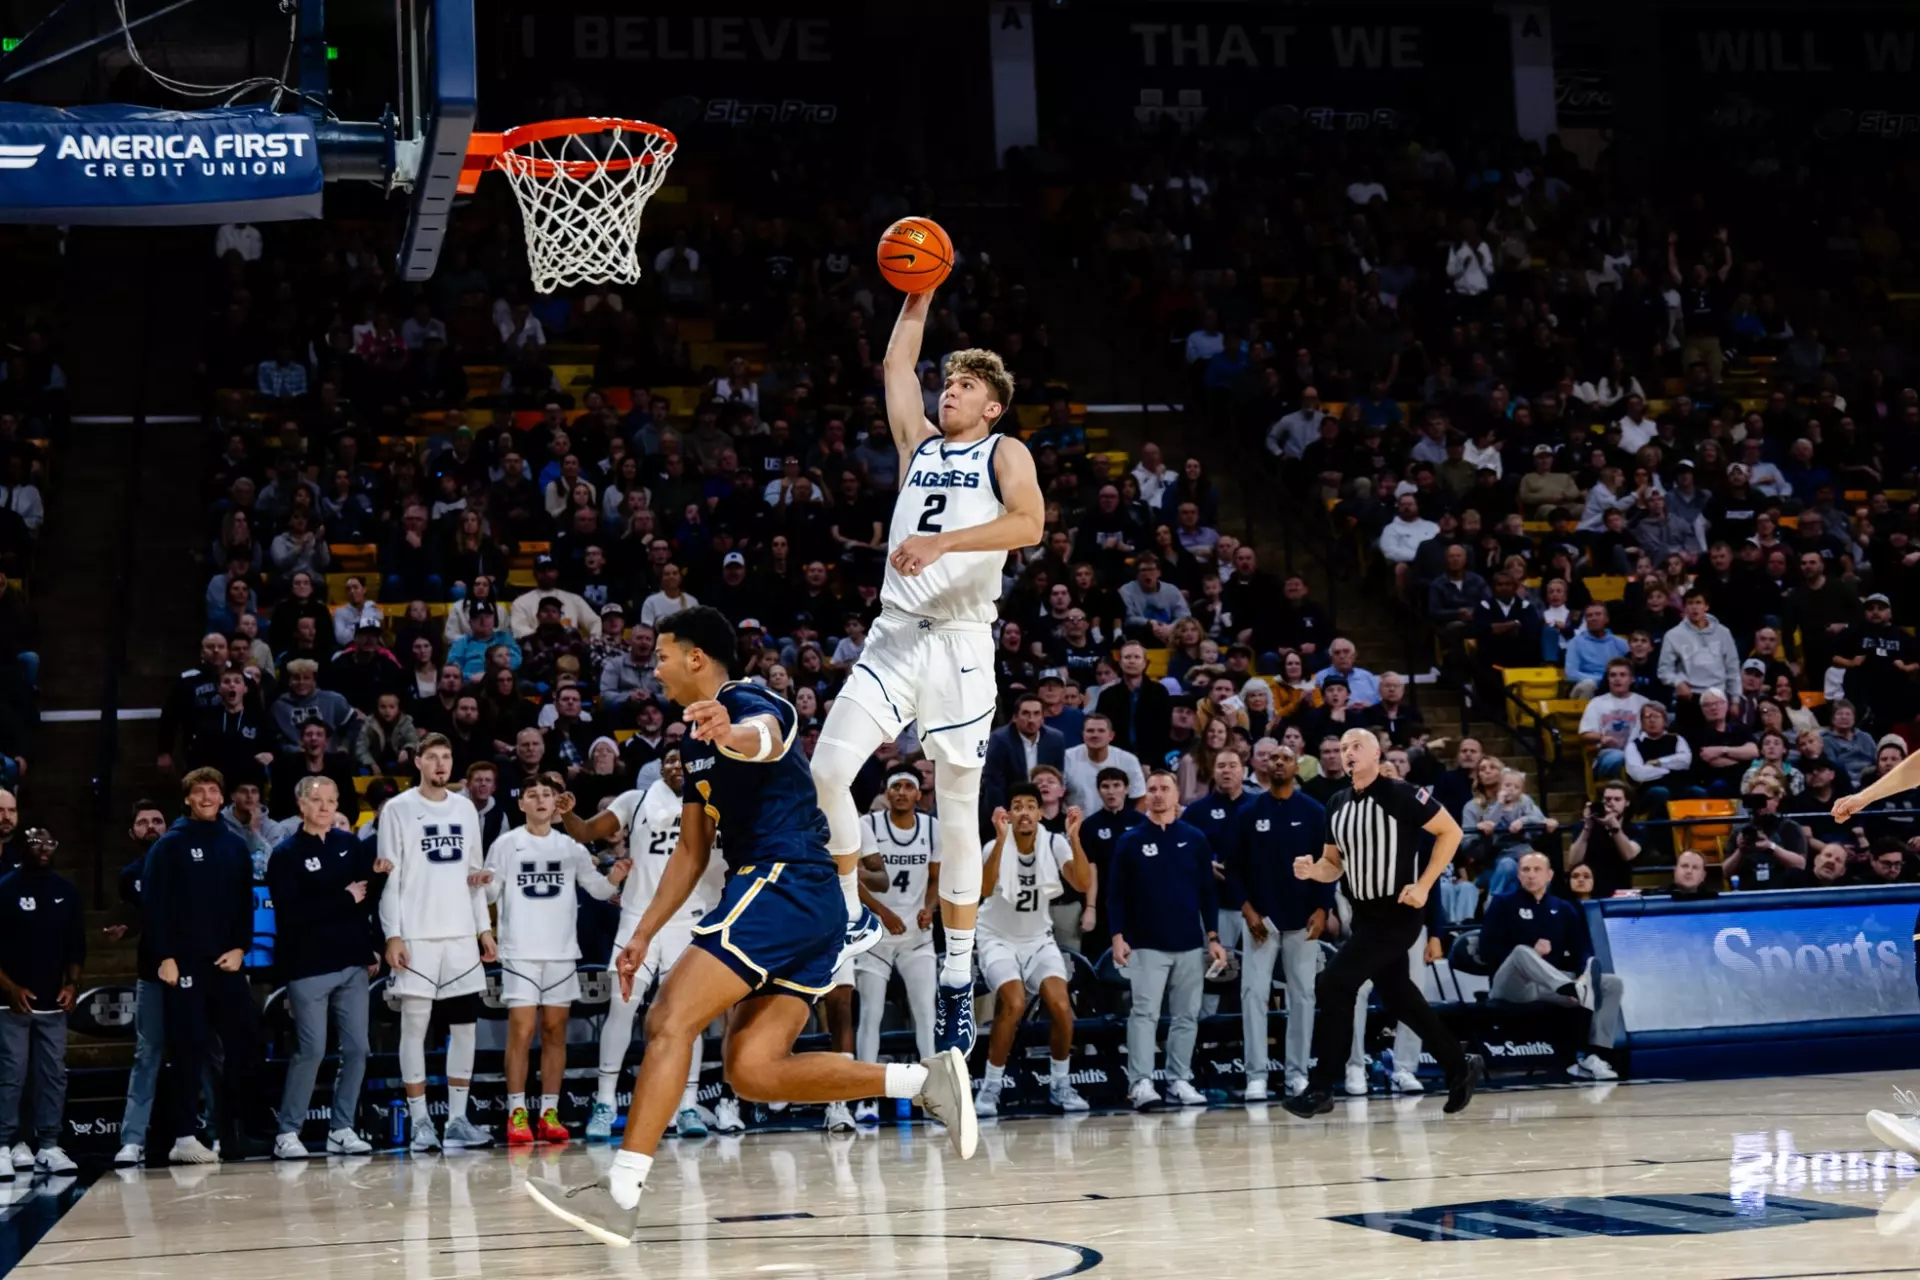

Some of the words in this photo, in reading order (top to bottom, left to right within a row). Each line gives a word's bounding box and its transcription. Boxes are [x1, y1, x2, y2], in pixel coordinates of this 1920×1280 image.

[574, 14, 833, 62] BELIEVE
[1130, 23, 1297, 68] THAT
[1331, 25, 1424, 68] WE
[1697, 29, 1834, 73] WILL
[56, 134, 209, 161] AMERICA
[214, 132, 310, 158] FIRST
[84, 162, 186, 178] CREDIT
[202, 160, 286, 176] UNION
[917, 494, 947, 533] 2
[883, 854, 928, 865] AGGIES
[517, 872, 565, 887] STATE
[892, 870, 910, 893] 4
[1016, 889, 1038, 912] 21
[1069, 1068, 1108, 1085] mith's
